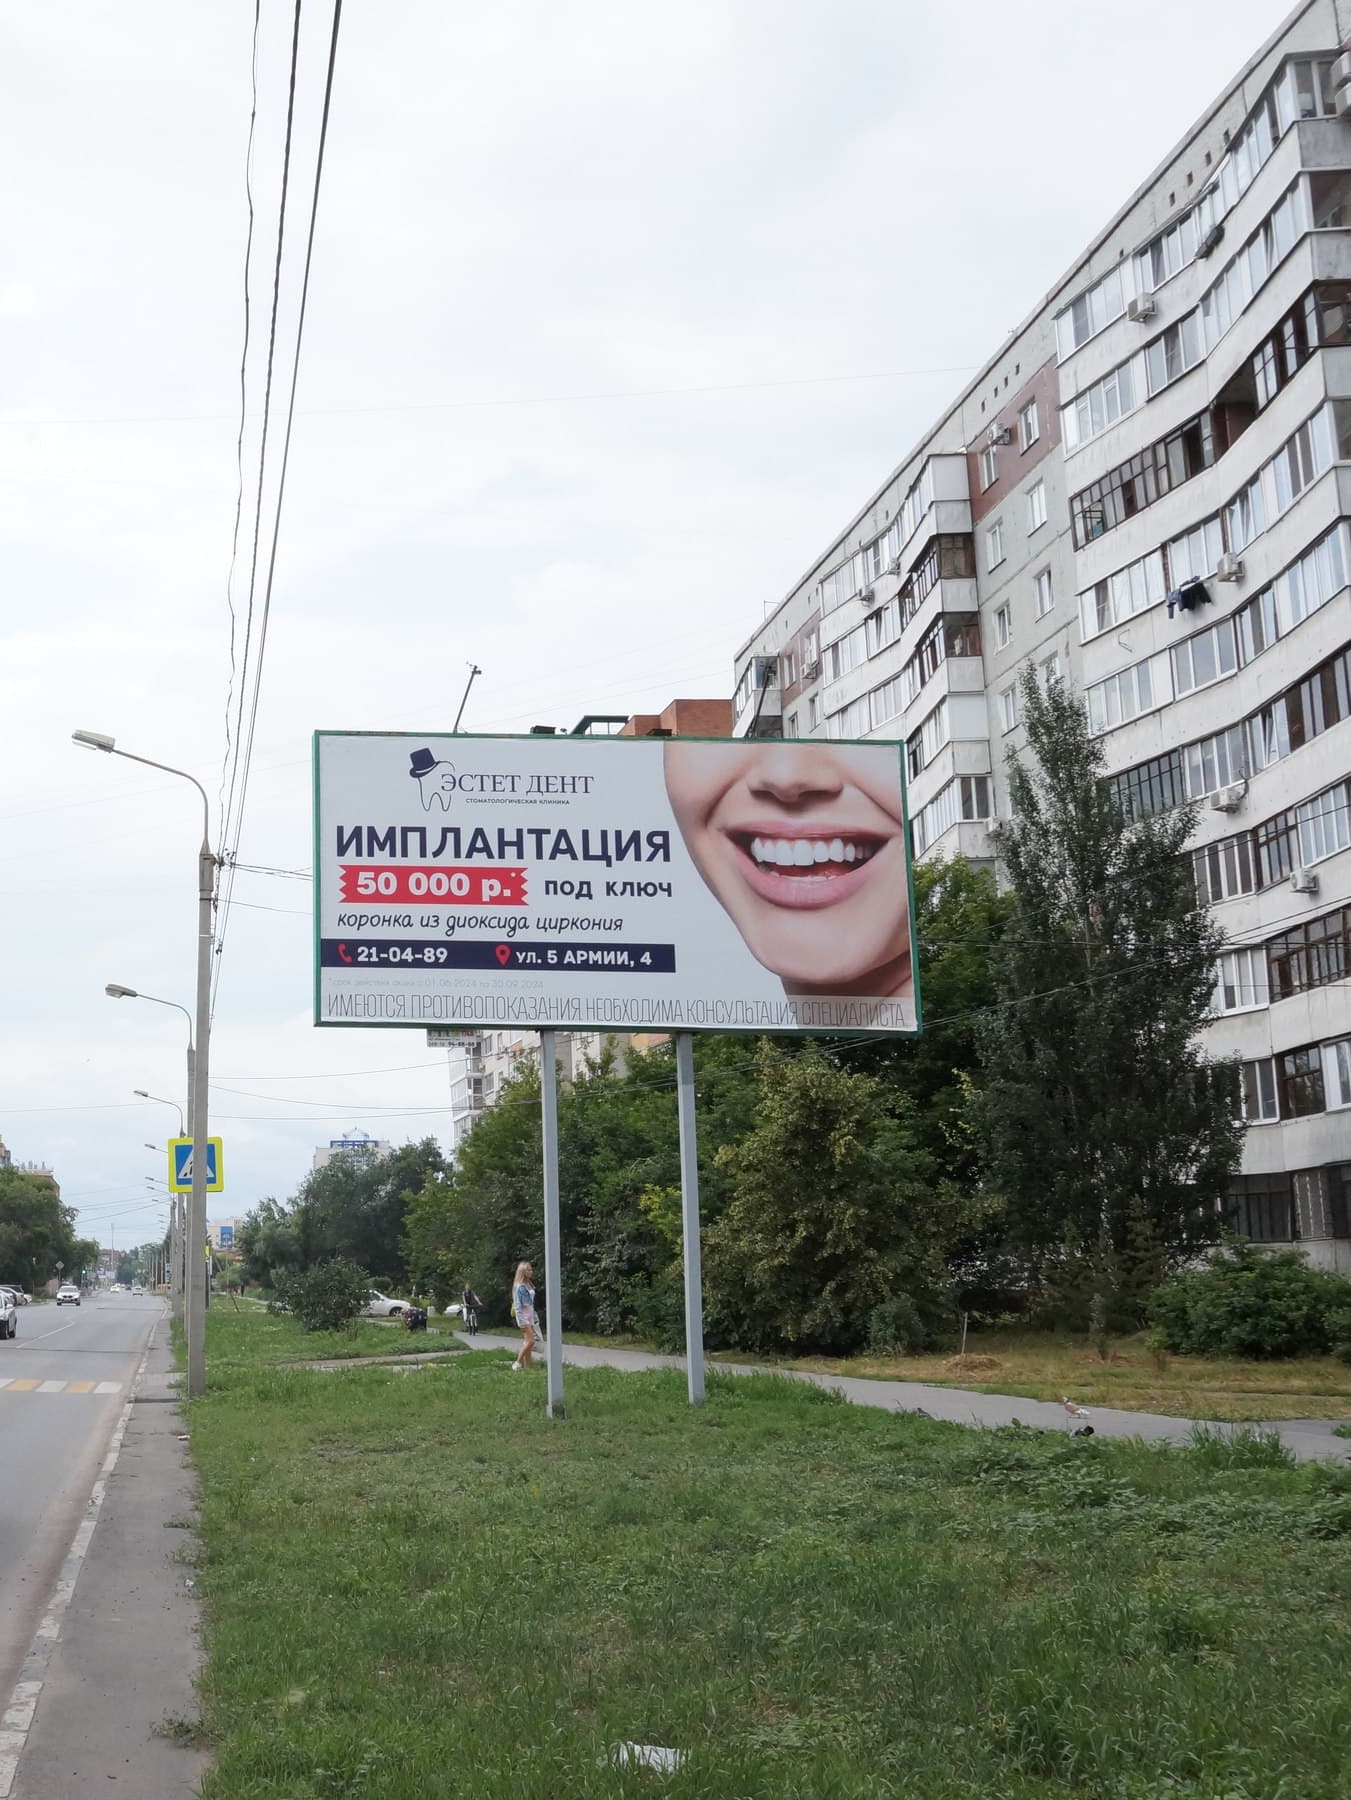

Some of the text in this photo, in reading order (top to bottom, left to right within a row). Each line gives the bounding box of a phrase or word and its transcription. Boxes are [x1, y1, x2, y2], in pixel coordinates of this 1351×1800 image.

[441, 773, 594, 796] ЭСТЕТ ДЕНТ
[465, 798, 537, 806] СТОМАТОЛОГИЧЕСКАЯ
[336, 825, 671, 867] ИМПЛАНТАЦИЯ
[356, 872, 397, 896] 50
[408, 873, 470, 897] 000
[544, 879, 593, 900] под
[605, 880, 673, 898] ключ
[337, 913, 623, 938] коронка из диоксида циркония
[357, 948, 448, 963] 21-04-89
[547, 950, 558, 964] 5
[563, 950, 634, 967] АРМИИ,
[639, 952, 653, 966] 4
[328, 993, 904, 1028] ИМЕЮТСЯ ПРОТИВОПОКАЗАНИЯ НЕОБХОДИМА КОНСУЛЬТАЦИЯ СПЕЦИАЛИСТА
